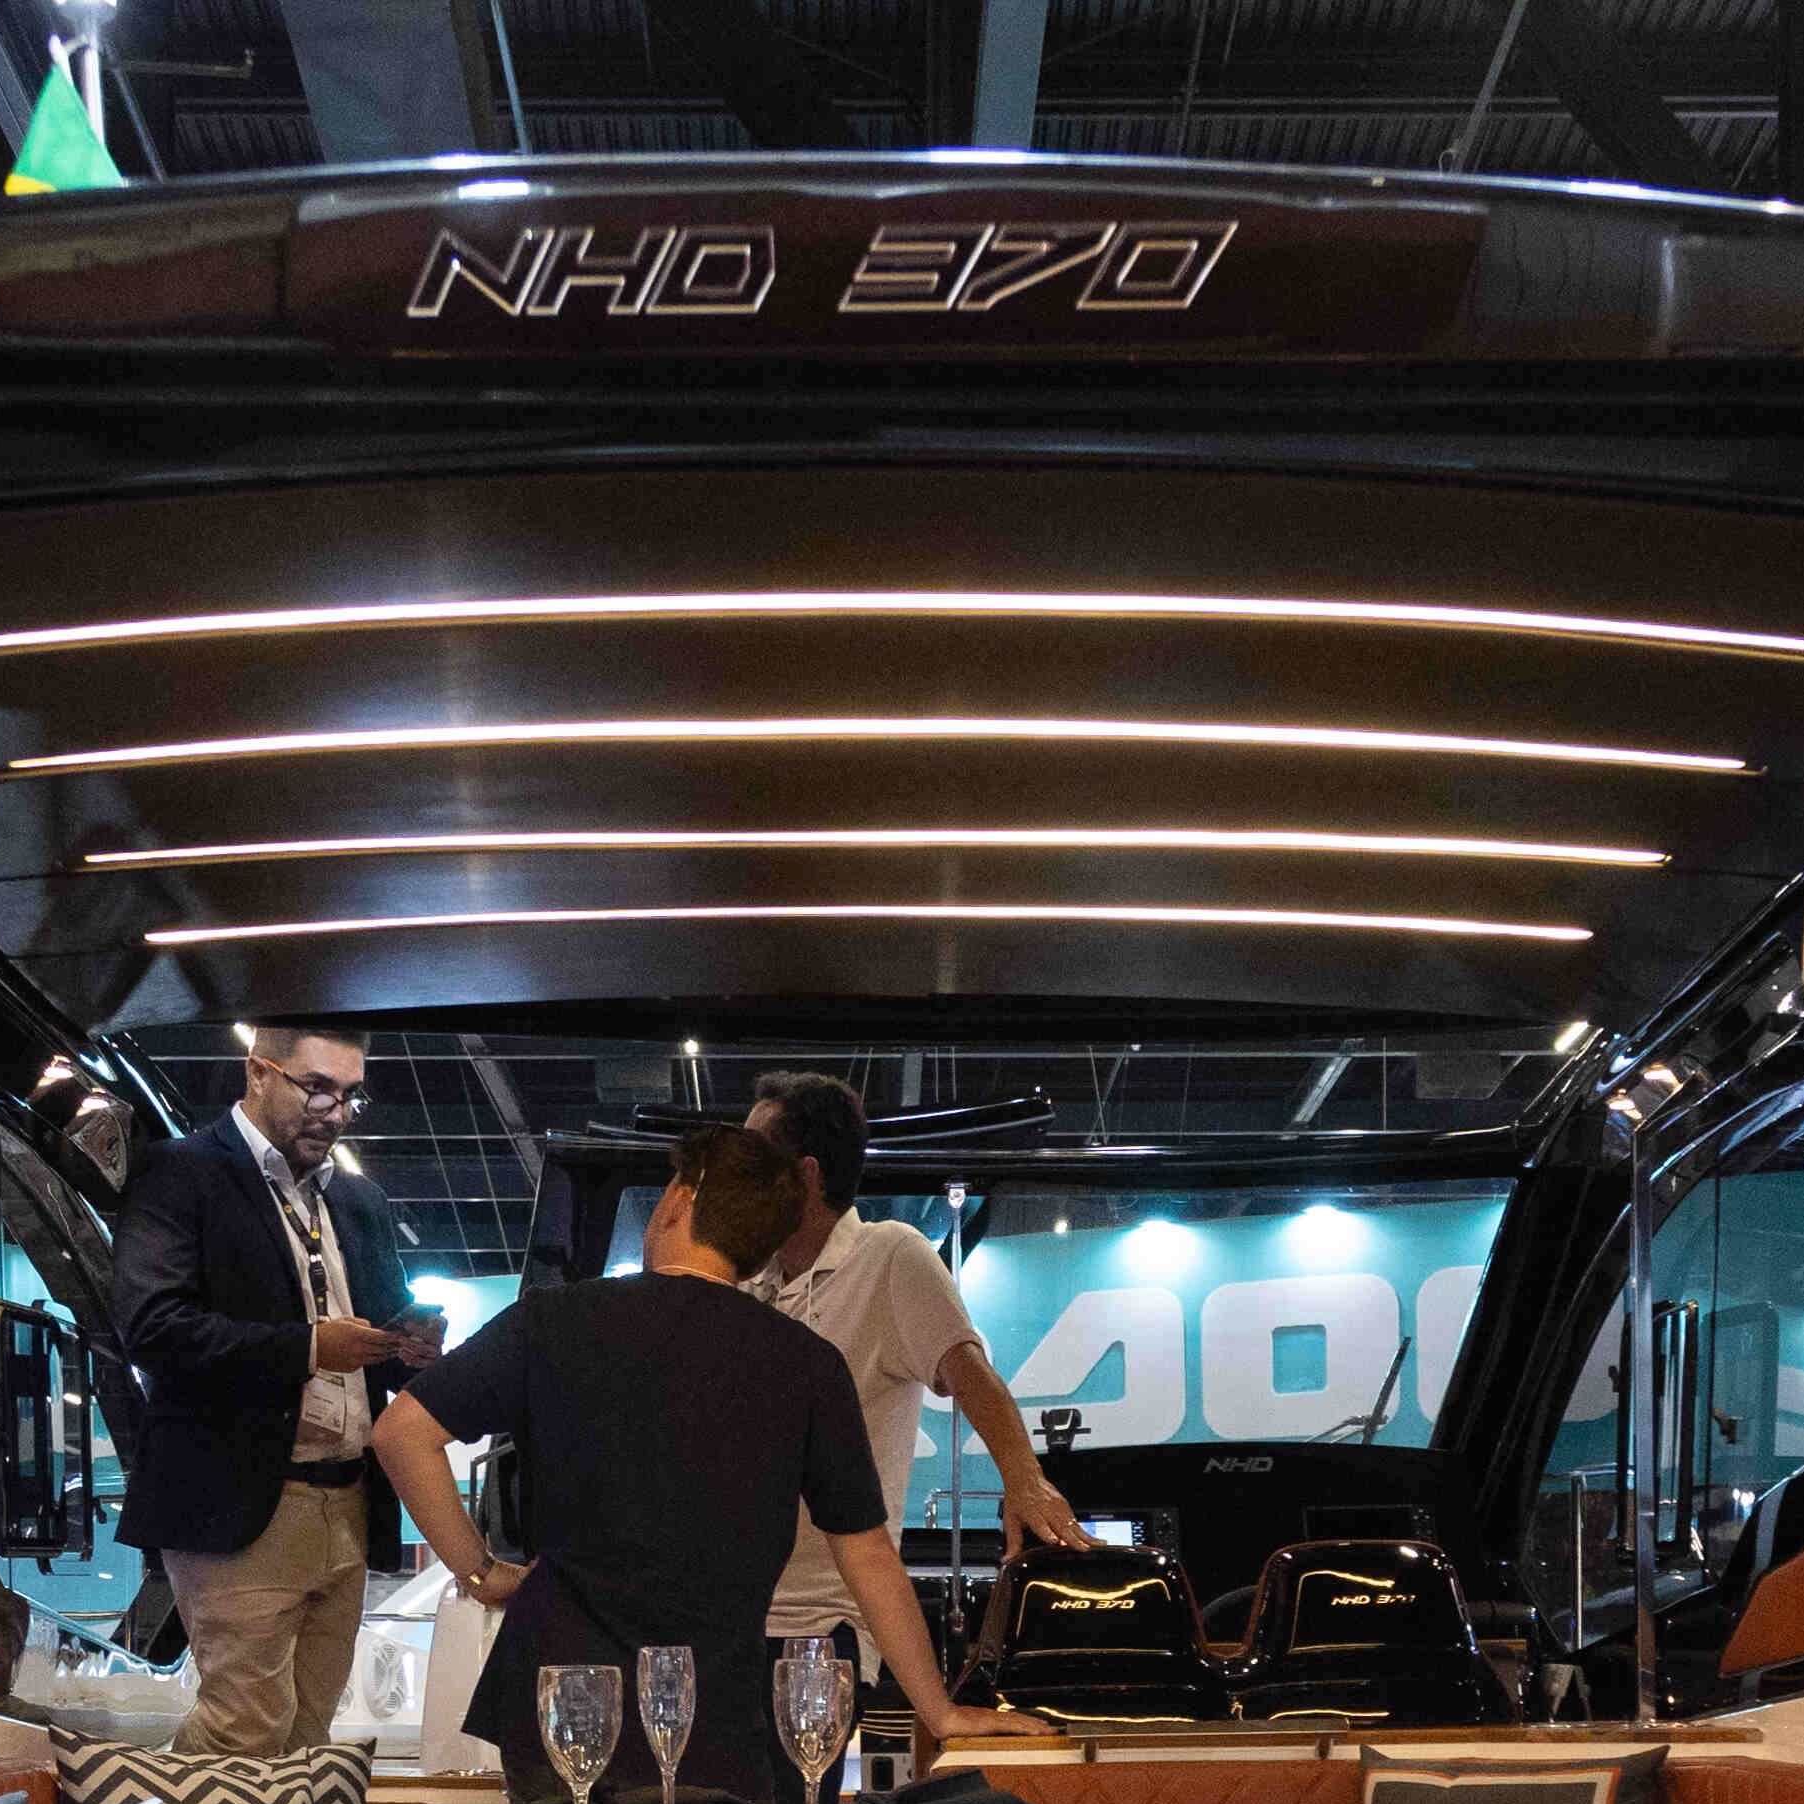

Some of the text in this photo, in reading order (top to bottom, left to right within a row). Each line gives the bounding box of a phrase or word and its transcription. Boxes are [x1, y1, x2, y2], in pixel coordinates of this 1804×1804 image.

[406, 220, 1239, 316] NHD 370
[1202, 1455, 1274, 1474] NHD
[1050, 1599, 1136, 1611] NHD 370
